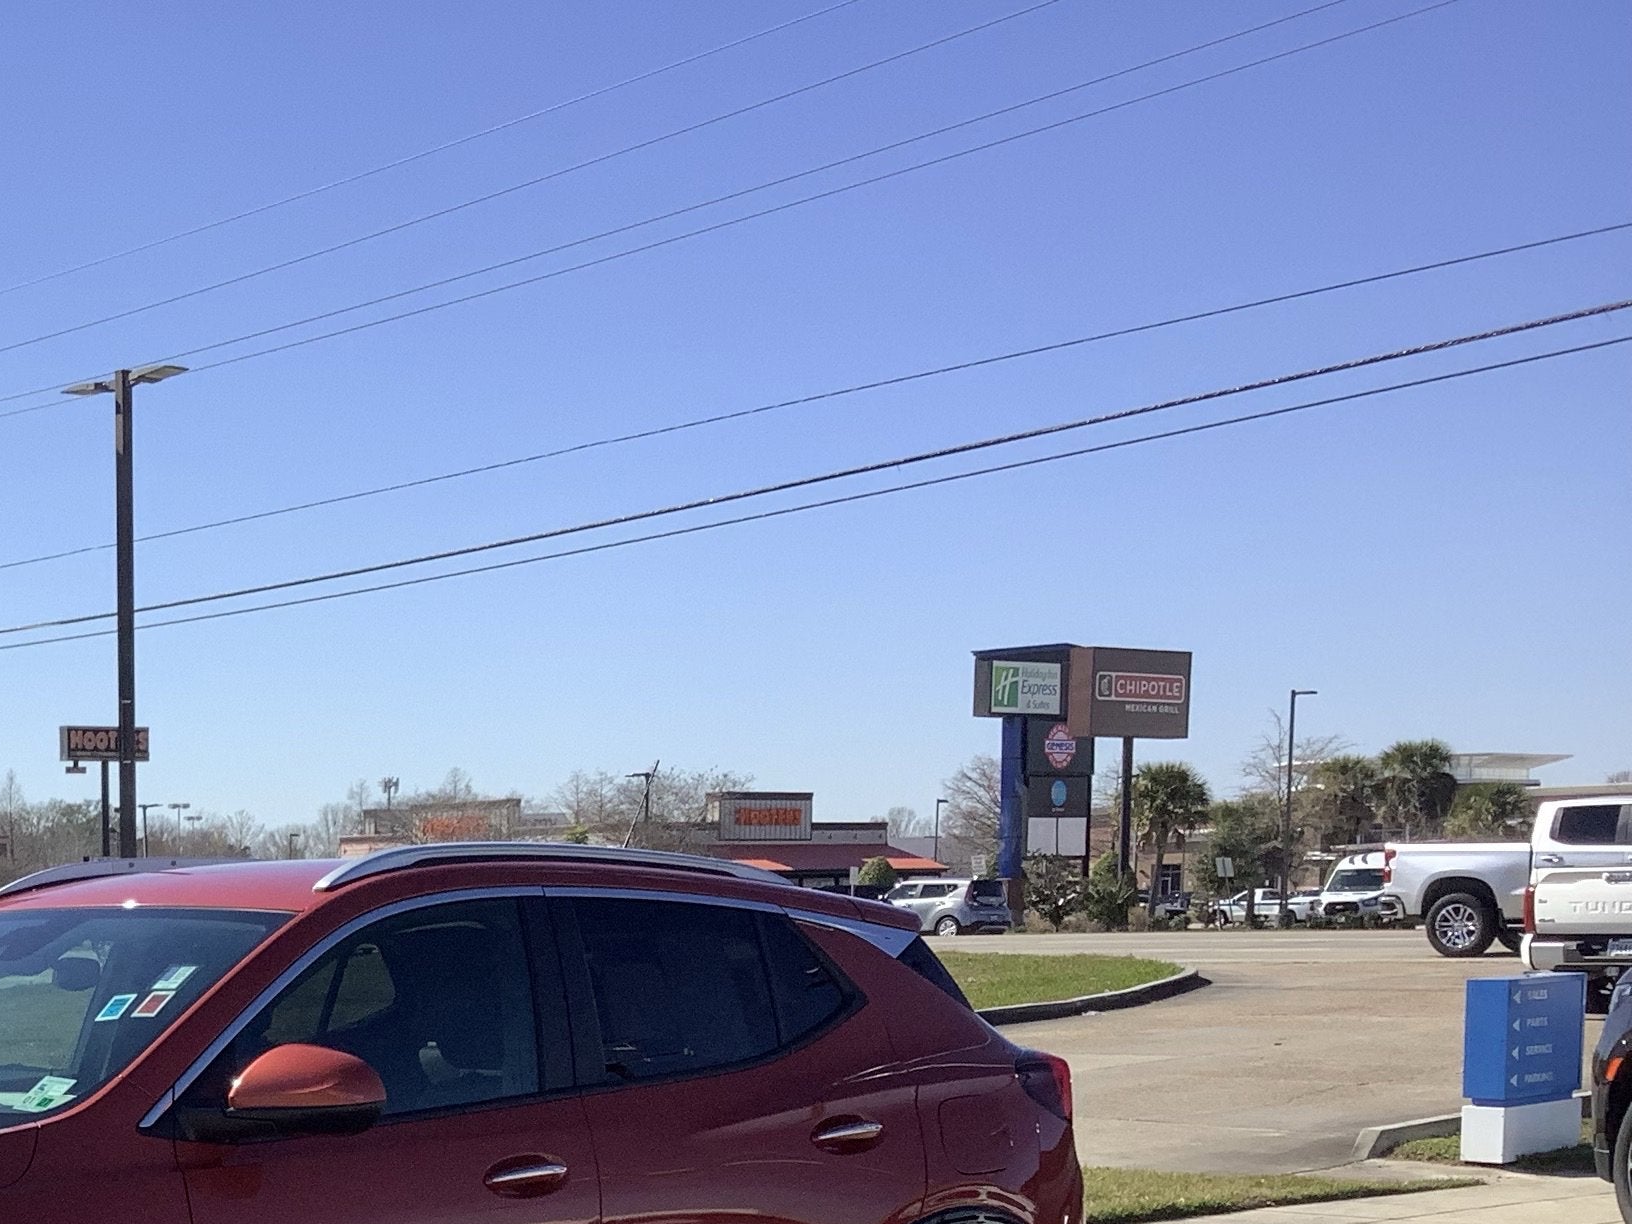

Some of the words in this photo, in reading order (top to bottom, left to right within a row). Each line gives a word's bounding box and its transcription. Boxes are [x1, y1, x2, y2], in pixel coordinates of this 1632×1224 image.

[1021, 679, 1058, 699] Express
[1116, 679, 1182, 697] CHIPOTLE
[1125, 703, 1157, 713] MEXICAN
[1158, 705, 1180, 714] GRILL
[70, 730, 147, 750] HOOTS
[1527, 1017, 1548, 1028] PARTS
